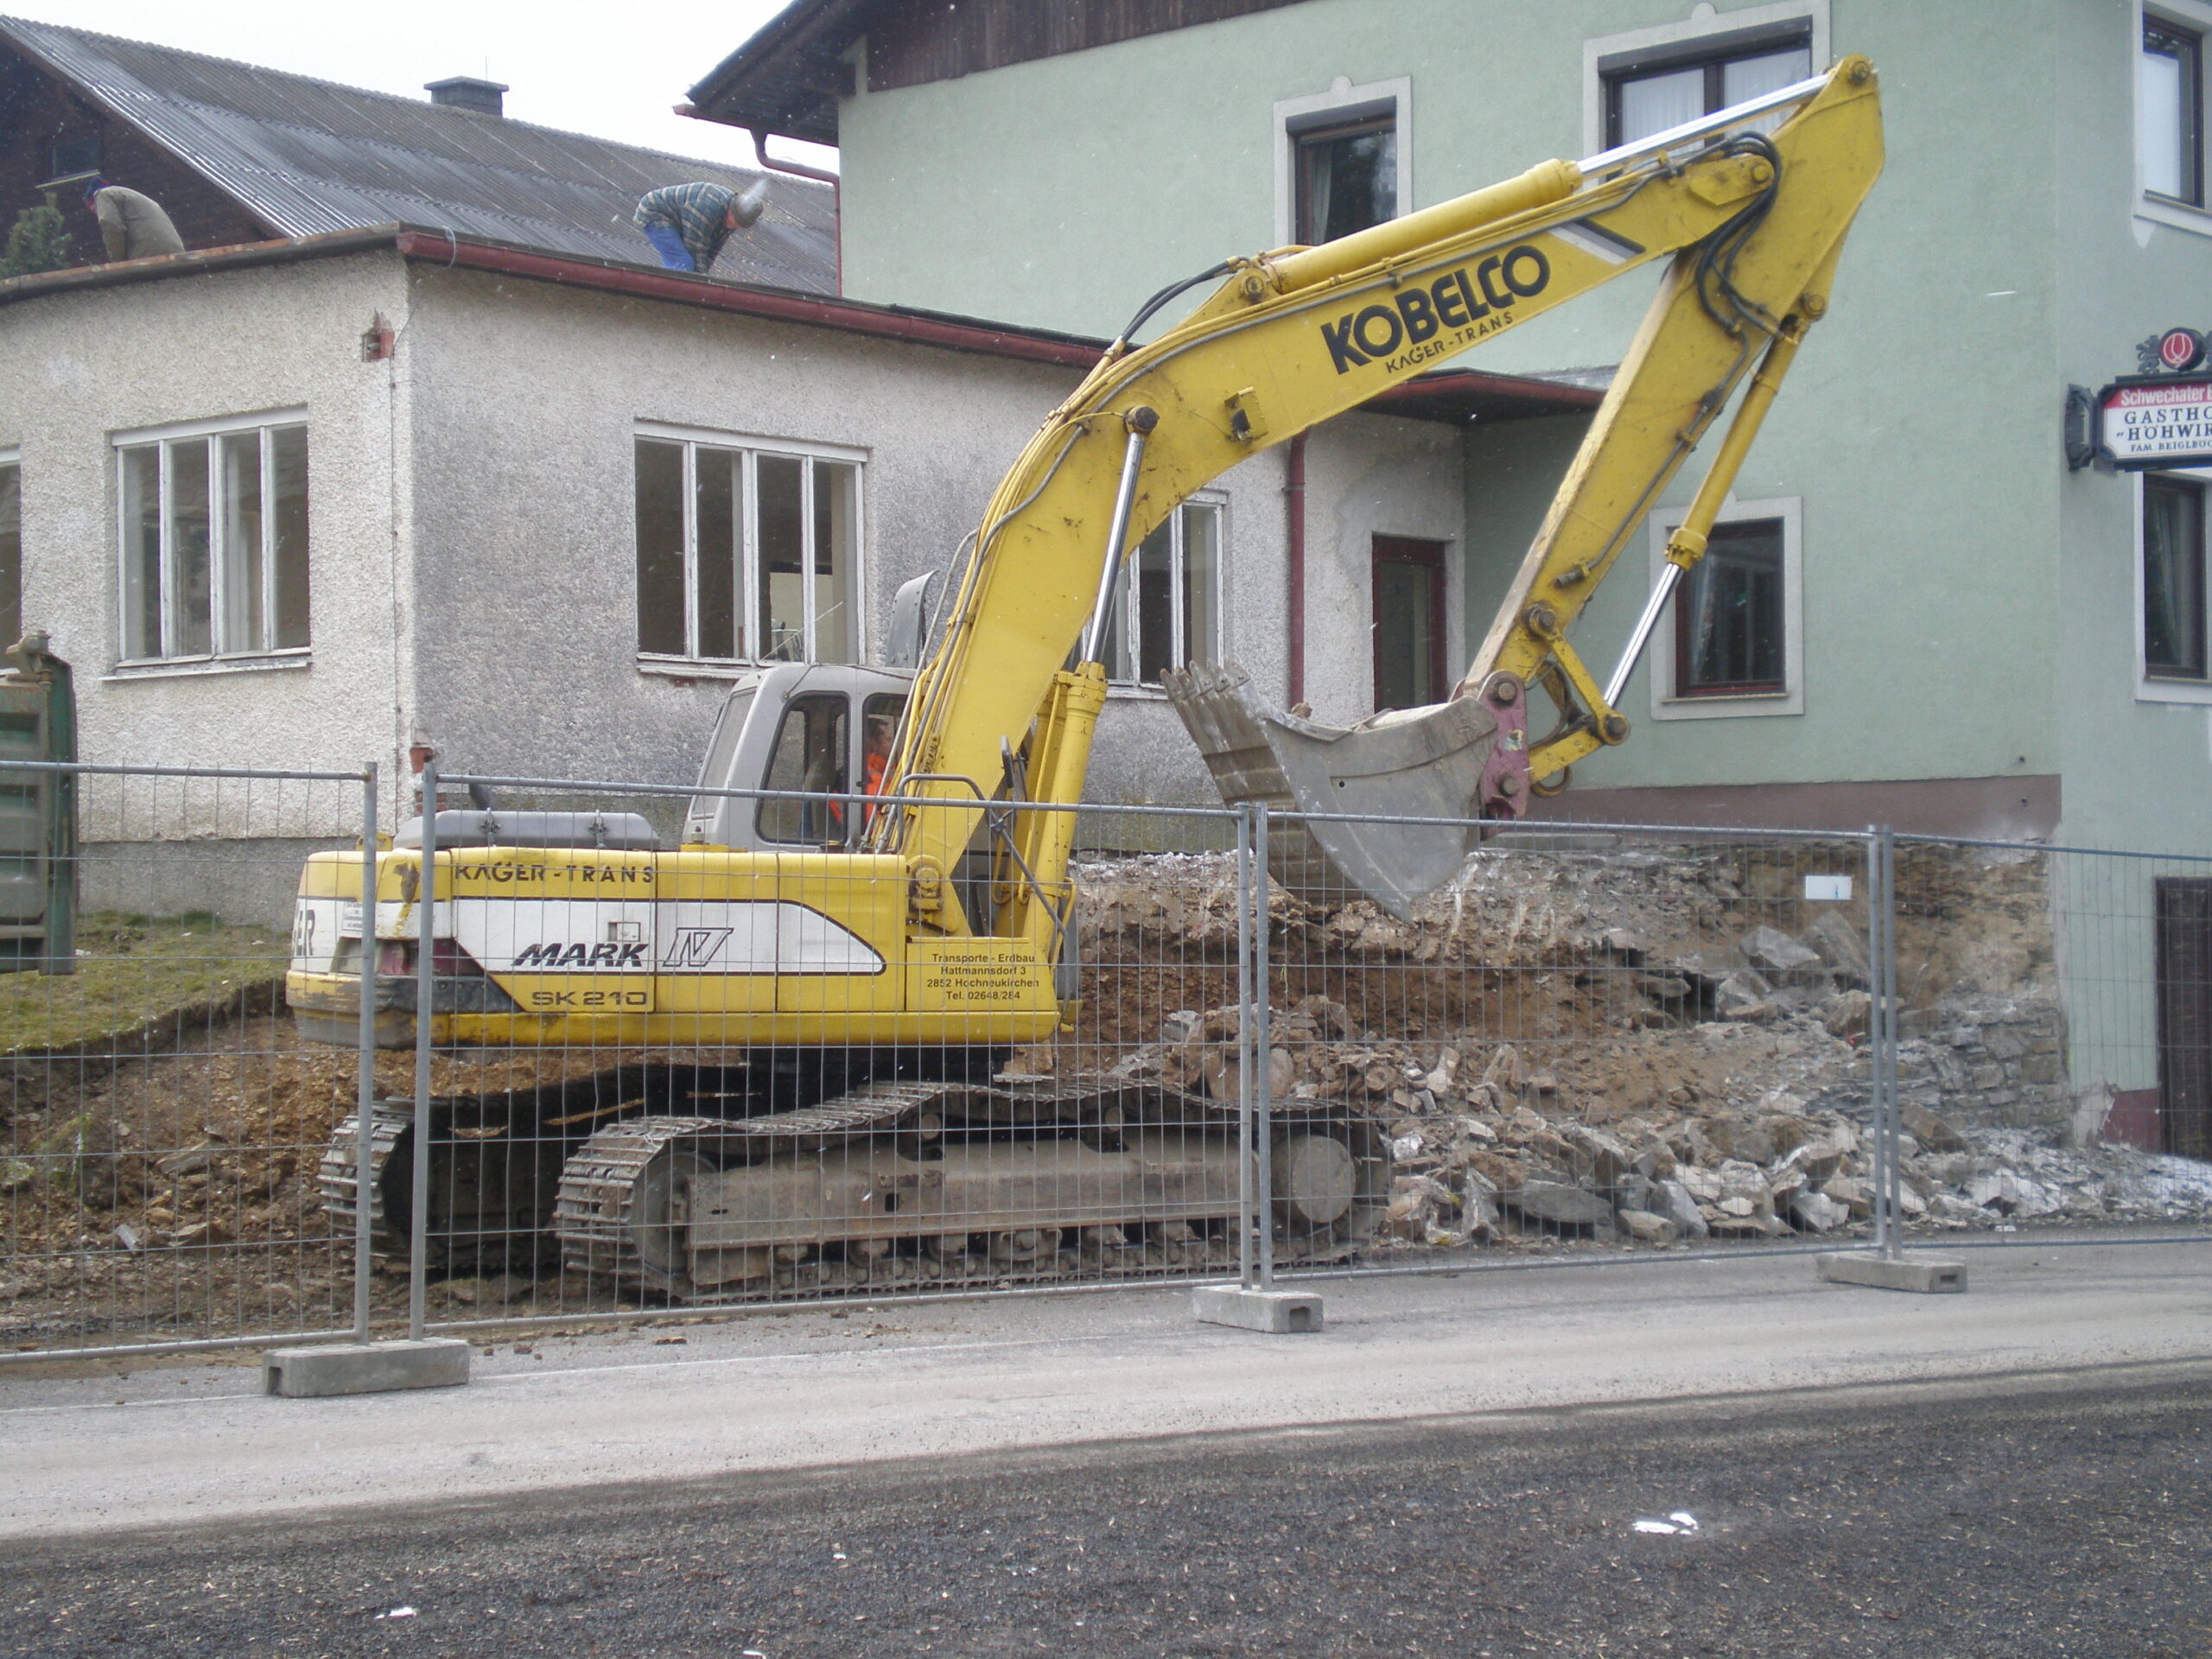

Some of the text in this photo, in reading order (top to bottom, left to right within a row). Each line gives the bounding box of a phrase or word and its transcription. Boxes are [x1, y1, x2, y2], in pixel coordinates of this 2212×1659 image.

[1320, 245, 1551, 375] KOBELCO
[2120, 386, 2206, 407] Schwechater
[511, 943, 649, 967] MARK
[931, 953, 988, 963] Transporte
[998, 953, 1035, 963] Erdbau
[940, 966, 1027, 976] Hattmannsdorf 3
[926, 977, 1039, 988] 2852 Hochneukirchen
[945, 990, 965, 1000] Tel.
